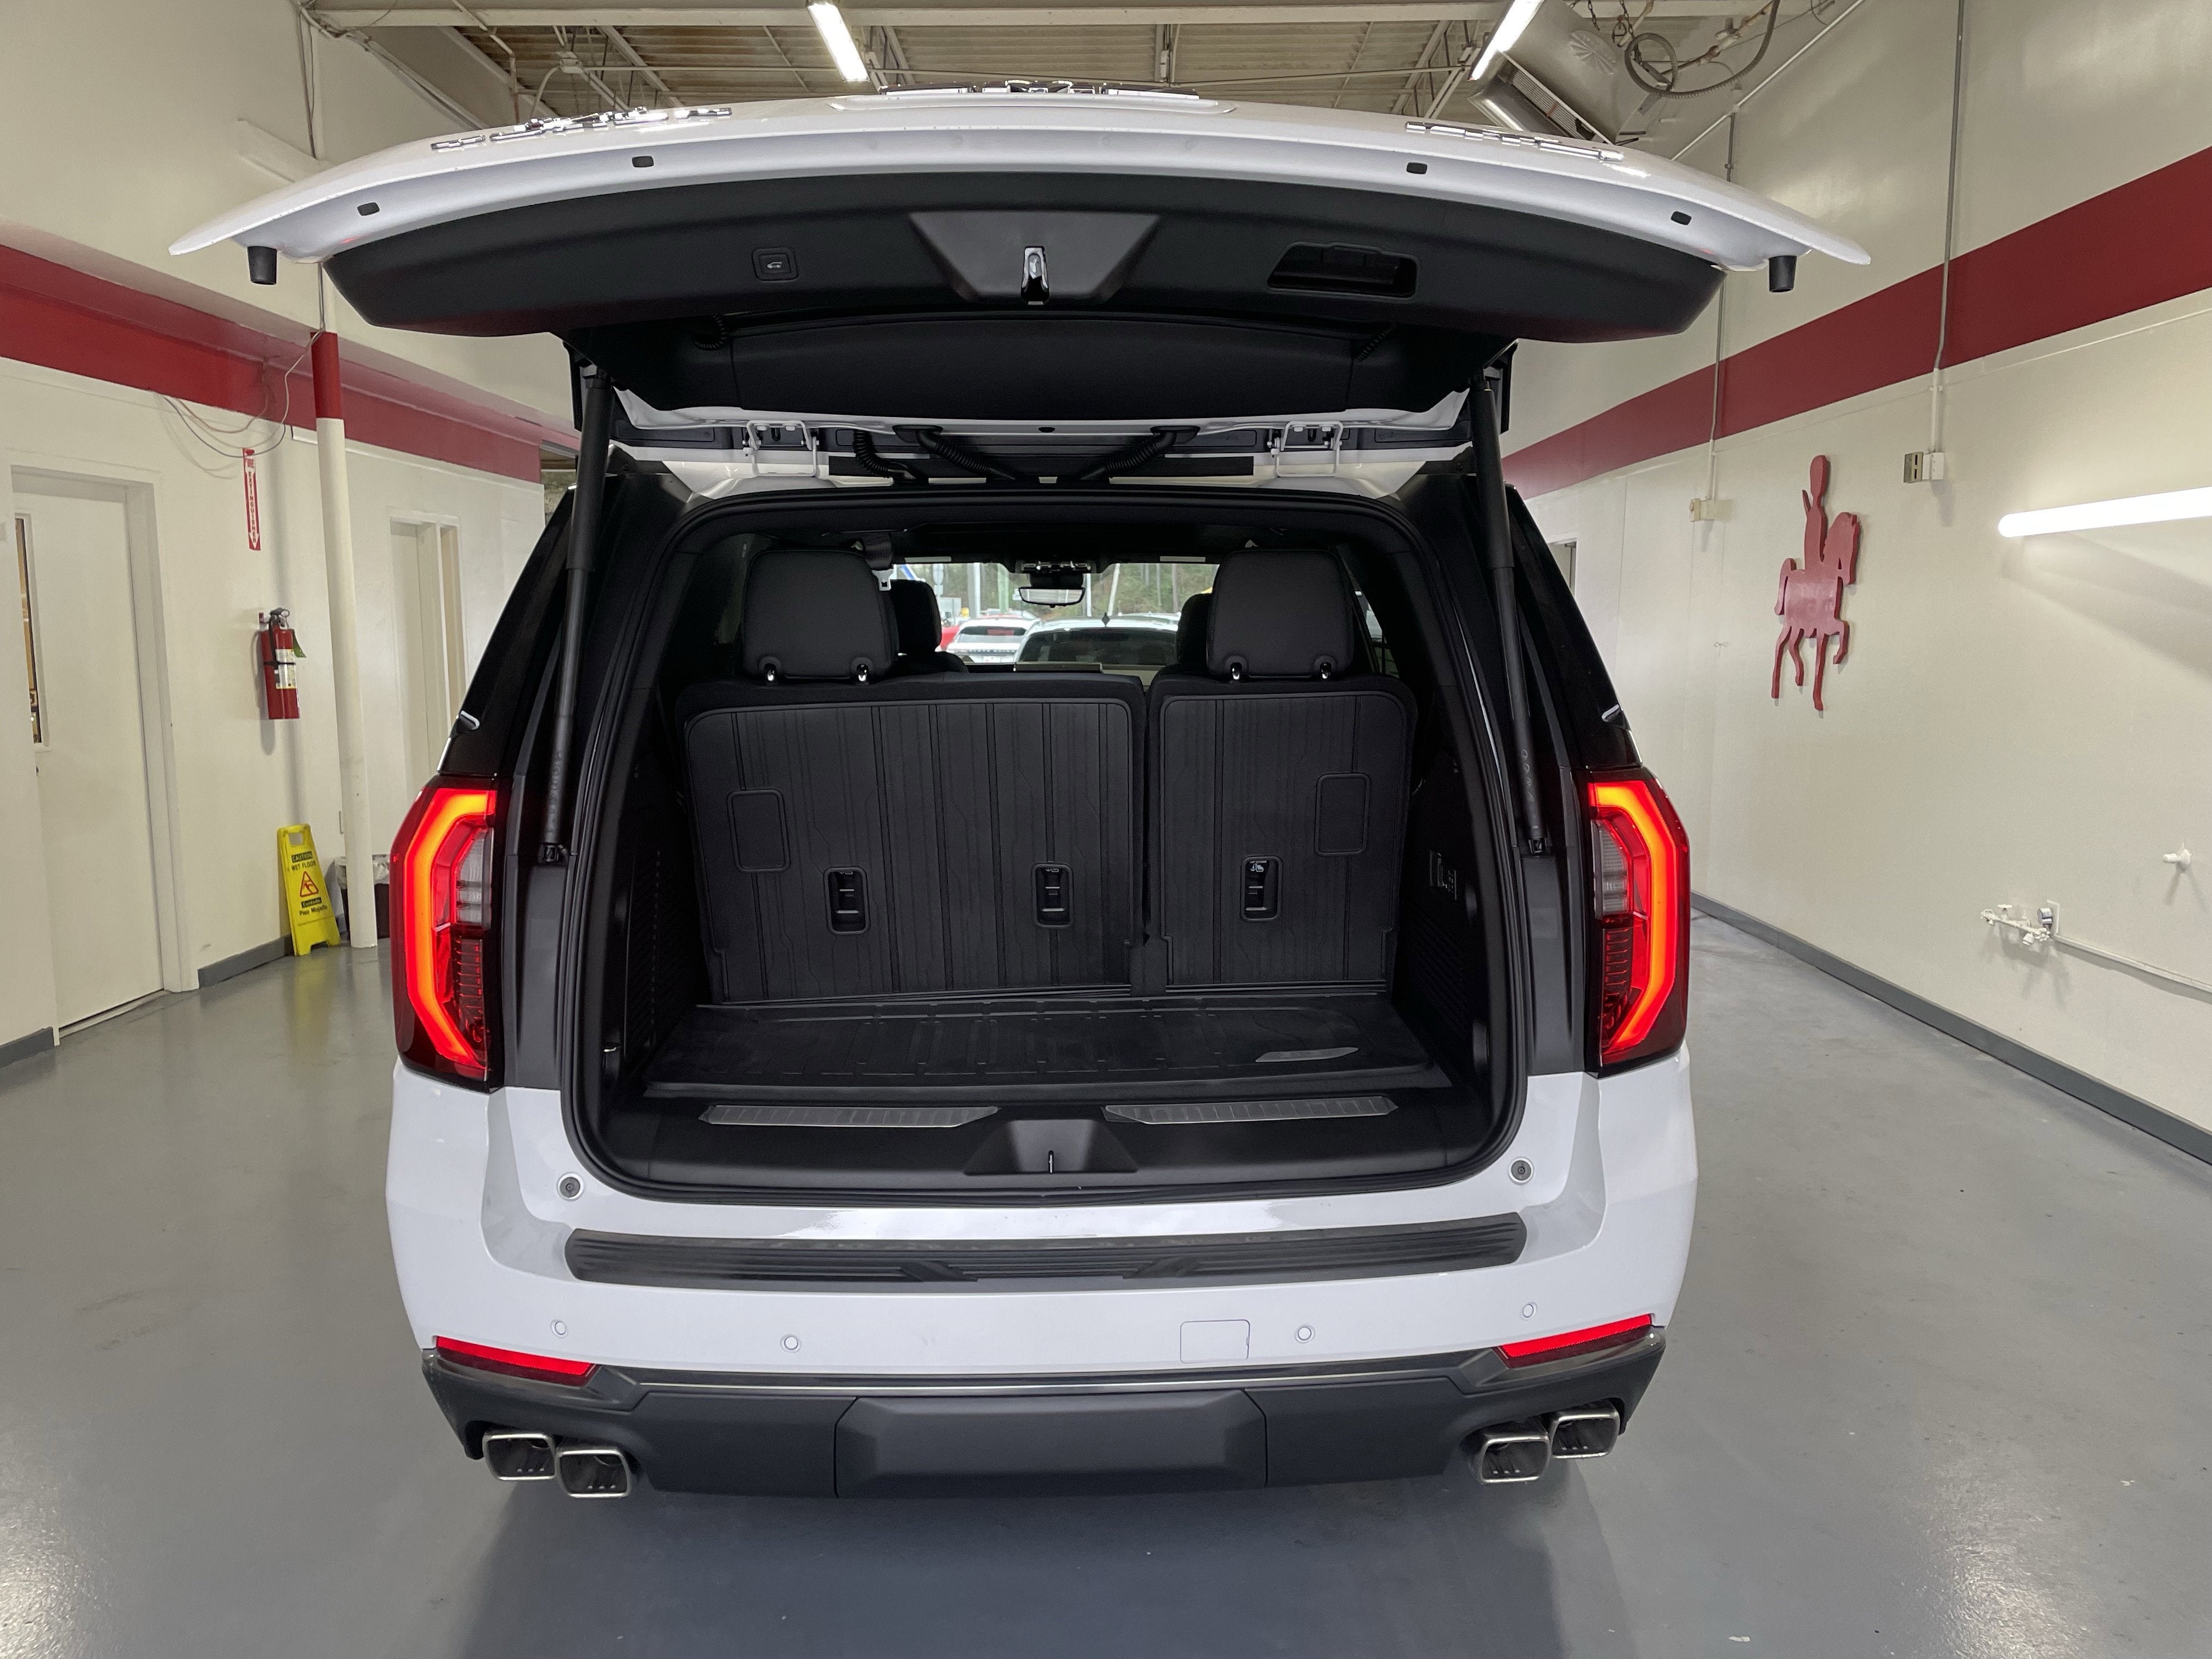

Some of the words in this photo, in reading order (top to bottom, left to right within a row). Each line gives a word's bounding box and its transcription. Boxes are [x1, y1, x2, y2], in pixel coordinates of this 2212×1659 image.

[248, 471, 256, 543] EXTINGUISHER
[292, 852, 312, 861] CAUTION
[302, 860, 317, 868] FLOOR
